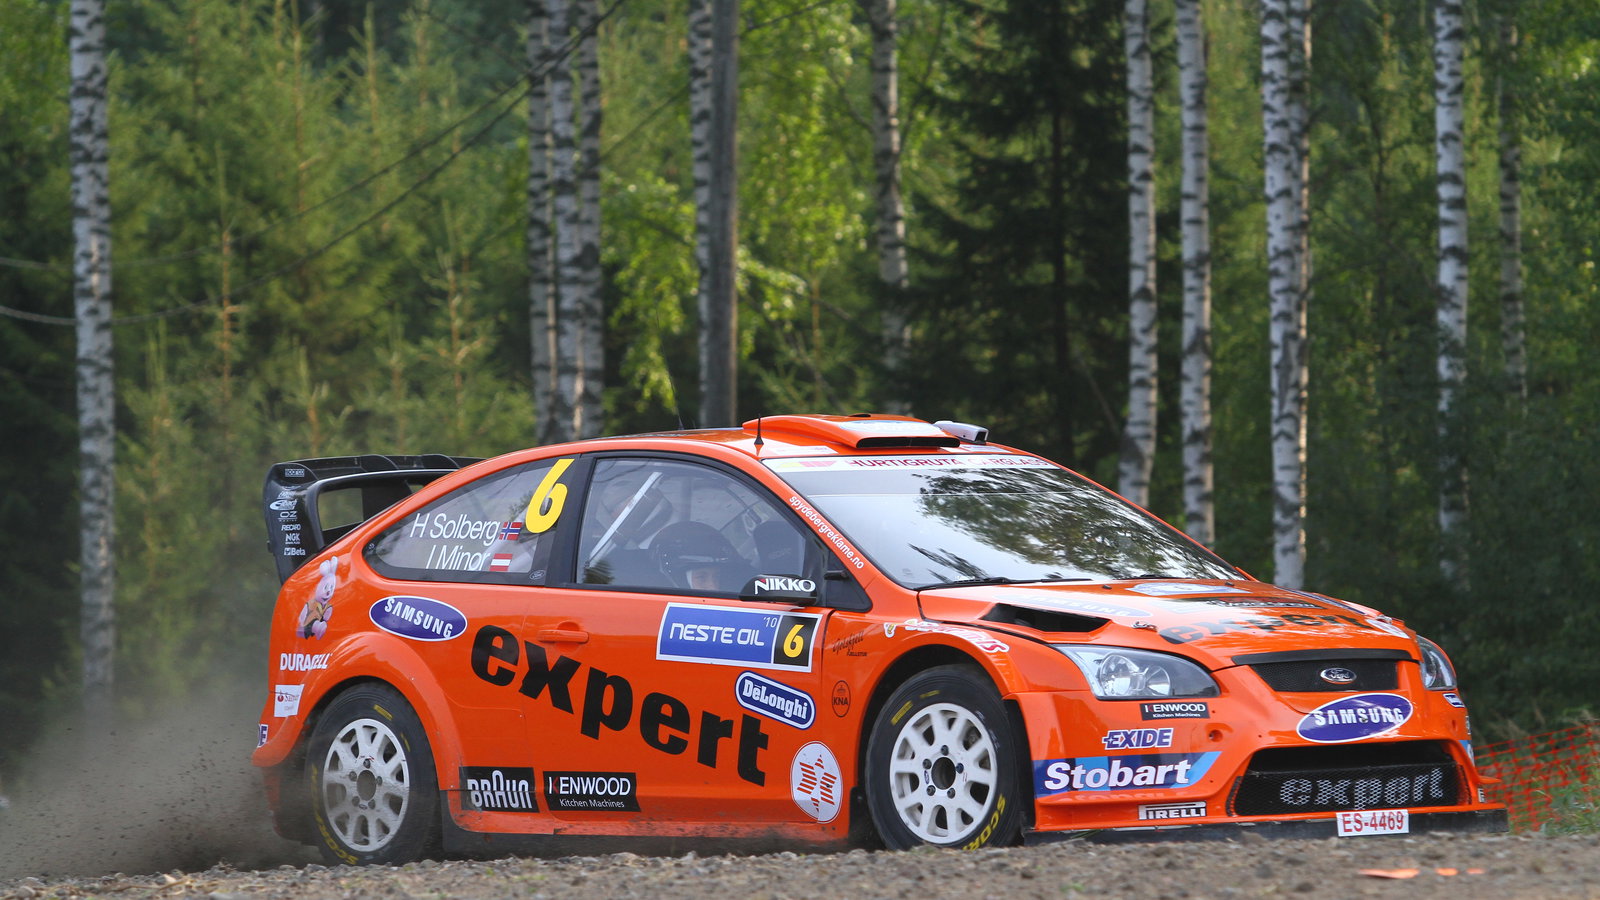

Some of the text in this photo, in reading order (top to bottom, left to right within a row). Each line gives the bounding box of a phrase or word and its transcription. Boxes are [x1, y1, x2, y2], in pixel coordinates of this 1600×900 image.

[525, 458, 575, 534] 6
[285, 533, 300, 541] NGK
[410, 513, 501, 546] H Solberg
[789, 495, 865, 569] spydebergreklame.no
[425, 545, 490, 571] I Minor
[754, 578, 816, 594] NIKKO
[384, 597, 454, 639] SAMSUNG
[669, 623, 765, 647] NESTE OIL
[783, 624, 804, 658] 6
[471, 624, 769, 787] expert
[833, 696, 849, 706] KNA
[1144, 703, 1206, 713] KENWOOD
[1314, 707, 1404, 726] SAMSUNG
[1104, 729, 1173, 749] EXIDE
[548, 776, 631, 796] KENWOOD
[1044, 759, 1191, 790] Stobart
[467, 770, 533, 808] BRAUN
[1280, 768, 1444, 810] expert
[559, 799, 625, 808] Kitchen Machines
[1138, 801, 1207, 820] PIRELLI
[962, 793, 1006, 852] SCOR
[1342, 812, 1404, 833] ES-4469
